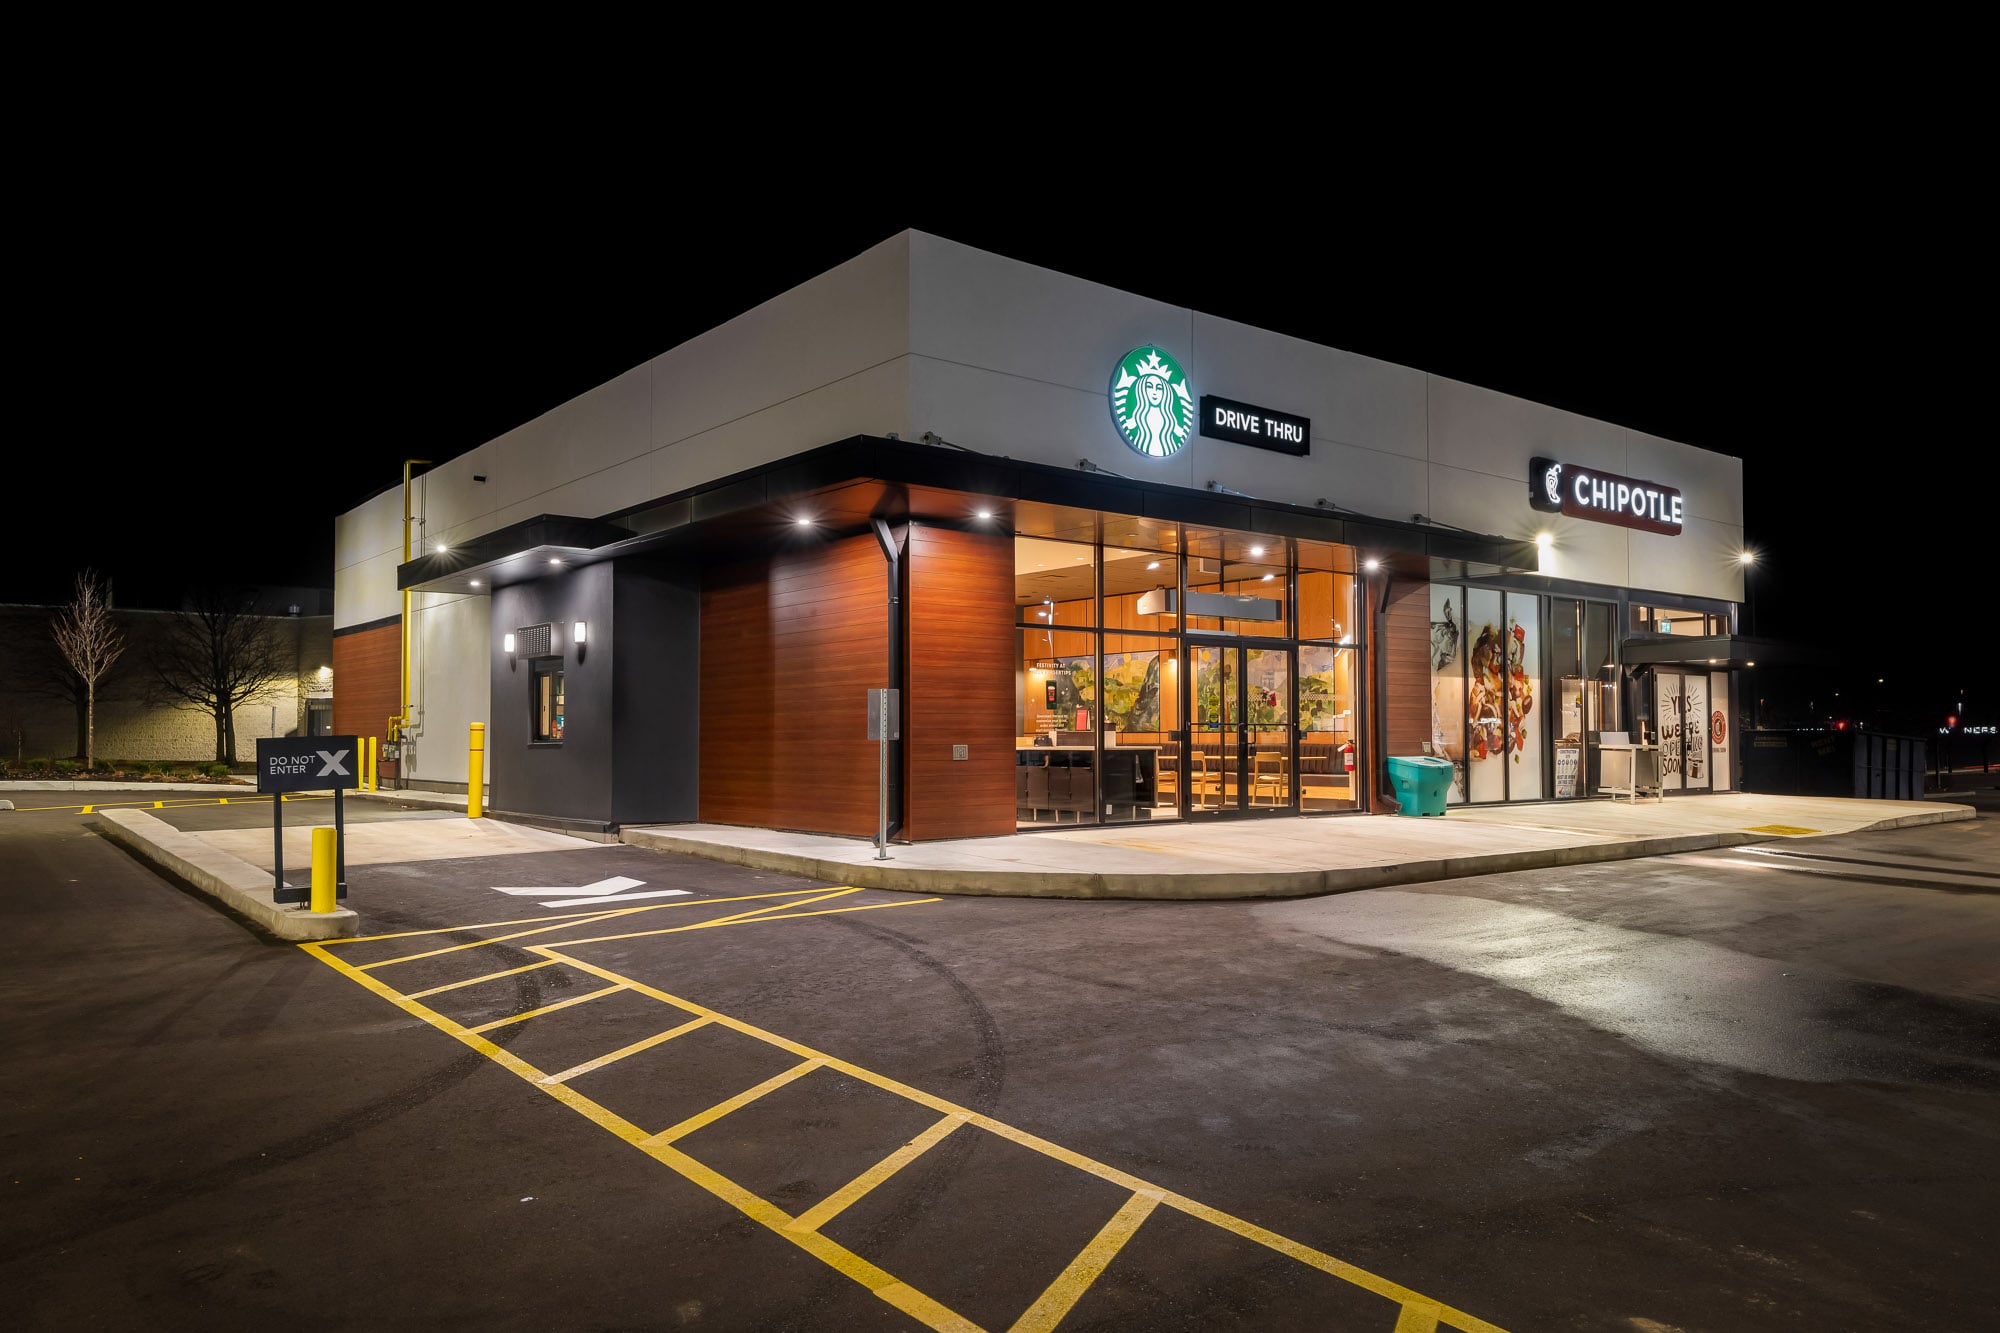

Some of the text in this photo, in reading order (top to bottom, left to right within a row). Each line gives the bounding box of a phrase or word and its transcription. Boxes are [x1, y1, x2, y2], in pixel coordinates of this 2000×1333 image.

[1215, 407, 1303, 443] DRIVE THRU
[1574, 475, 1683, 524] CHIPOTLE
[269, 755, 316, 766] DO NOT
[270, 765, 306, 775] ENTER
